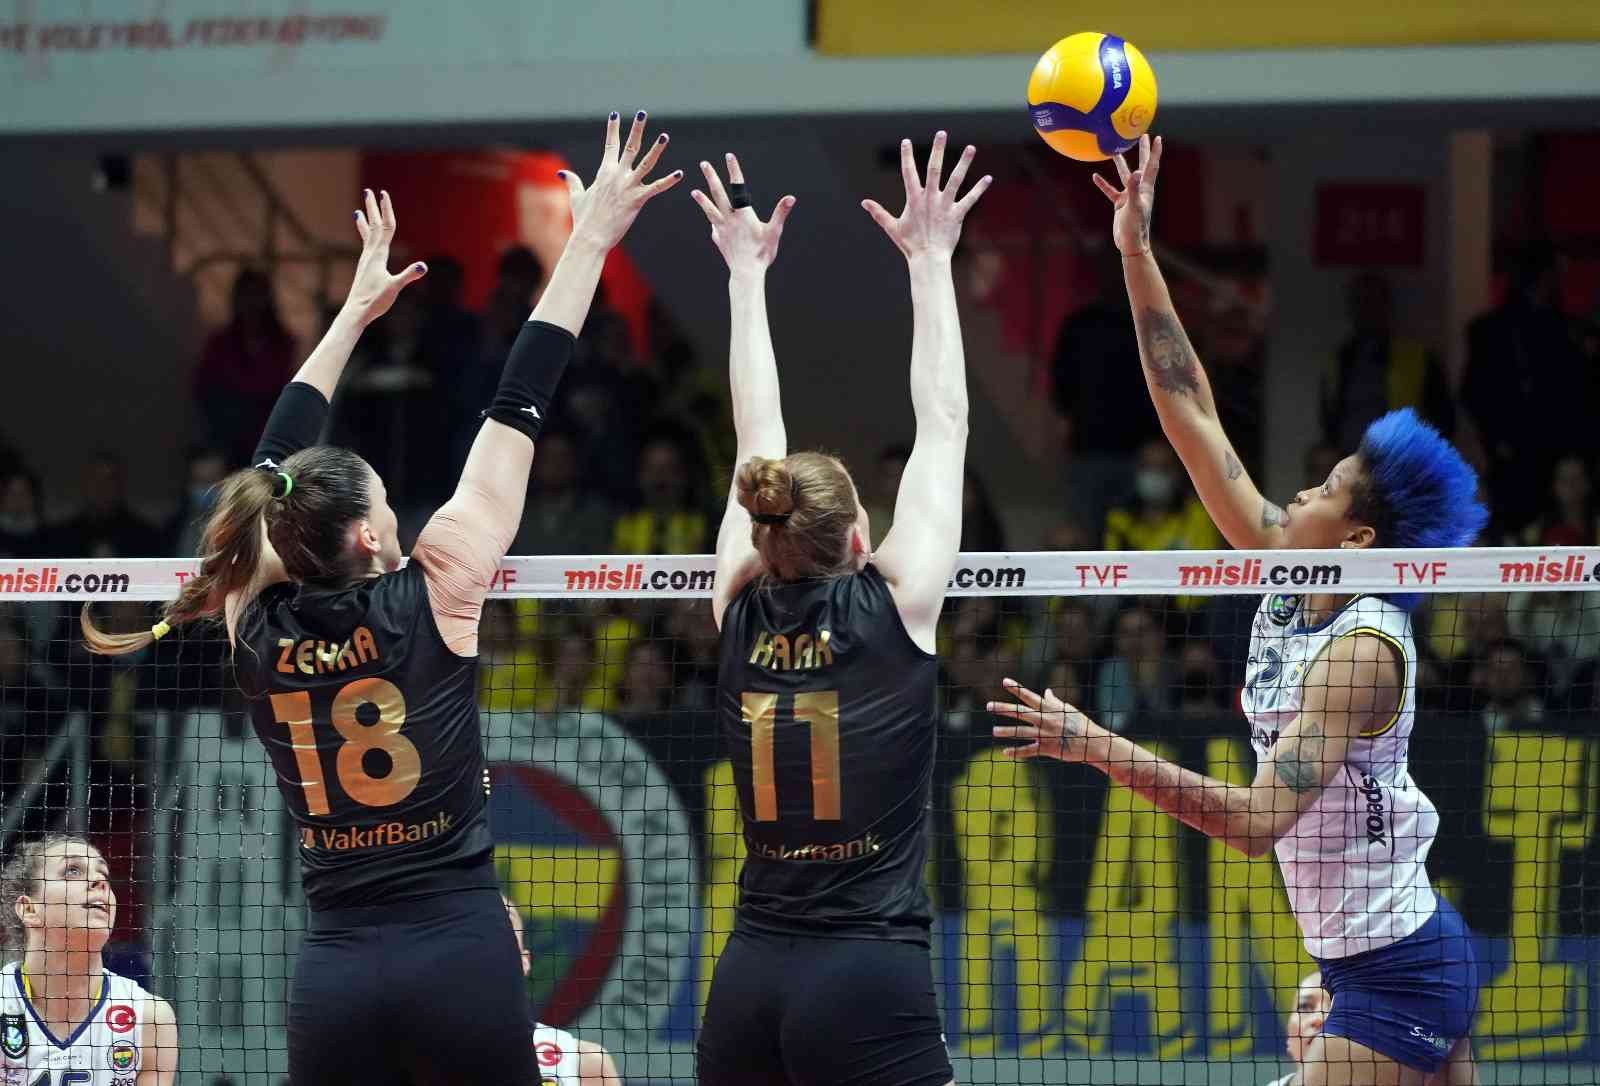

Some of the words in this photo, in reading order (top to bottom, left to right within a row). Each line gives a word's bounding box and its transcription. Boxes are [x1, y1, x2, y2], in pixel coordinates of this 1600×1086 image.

[1075, 565, 1129, 588] TVF
[1178, 558, 1342, 586] misli.com
[1393, 561, 1448, 585] TVF
[1499, 555, 1600, 583] misli.
[269, 677, 423, 816] 18
[741, 690, 841, 822] 11
